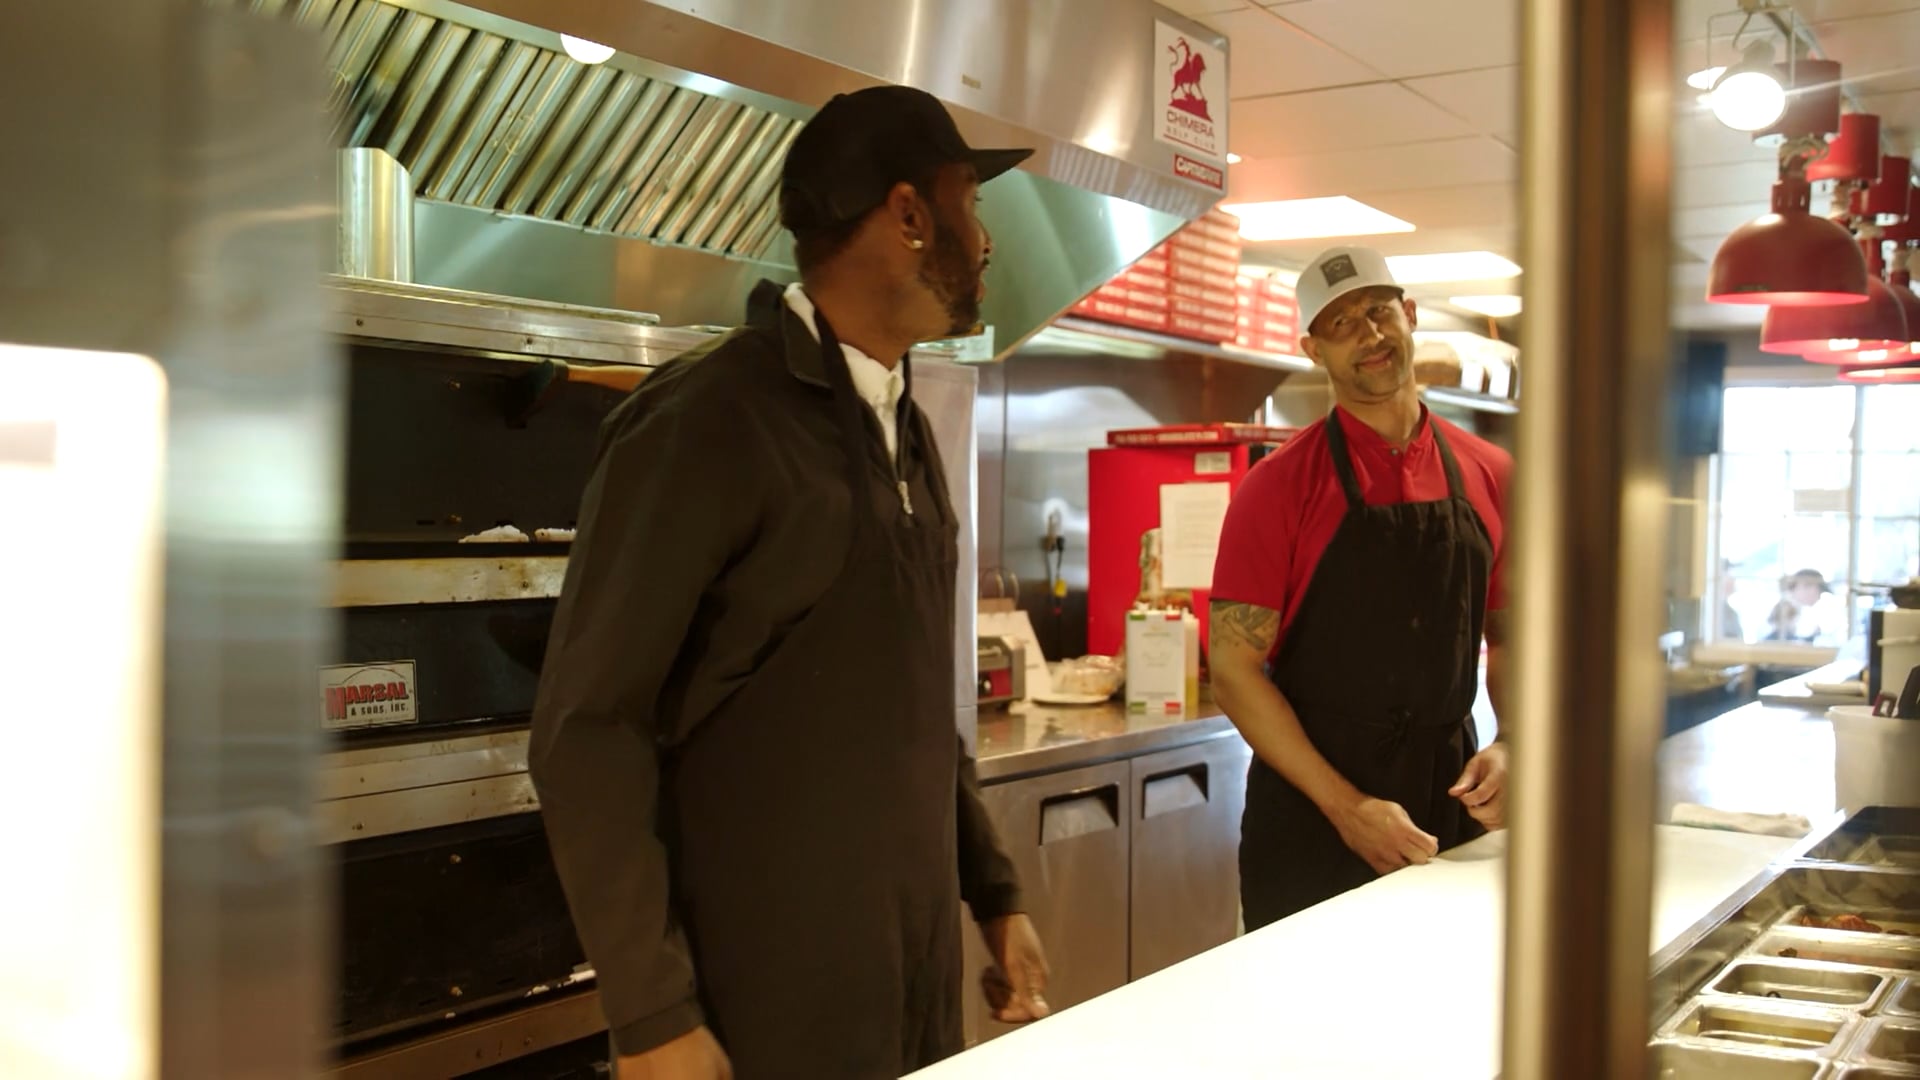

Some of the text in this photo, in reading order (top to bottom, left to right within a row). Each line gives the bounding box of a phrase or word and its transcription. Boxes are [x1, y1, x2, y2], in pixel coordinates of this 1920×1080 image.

[1166, 110, 1215, 137] CHIMERA
[325, 681, 409, 720] MARSAL
[351, 707, 357, 716] &
[390, 703, 410, 713] INC.
